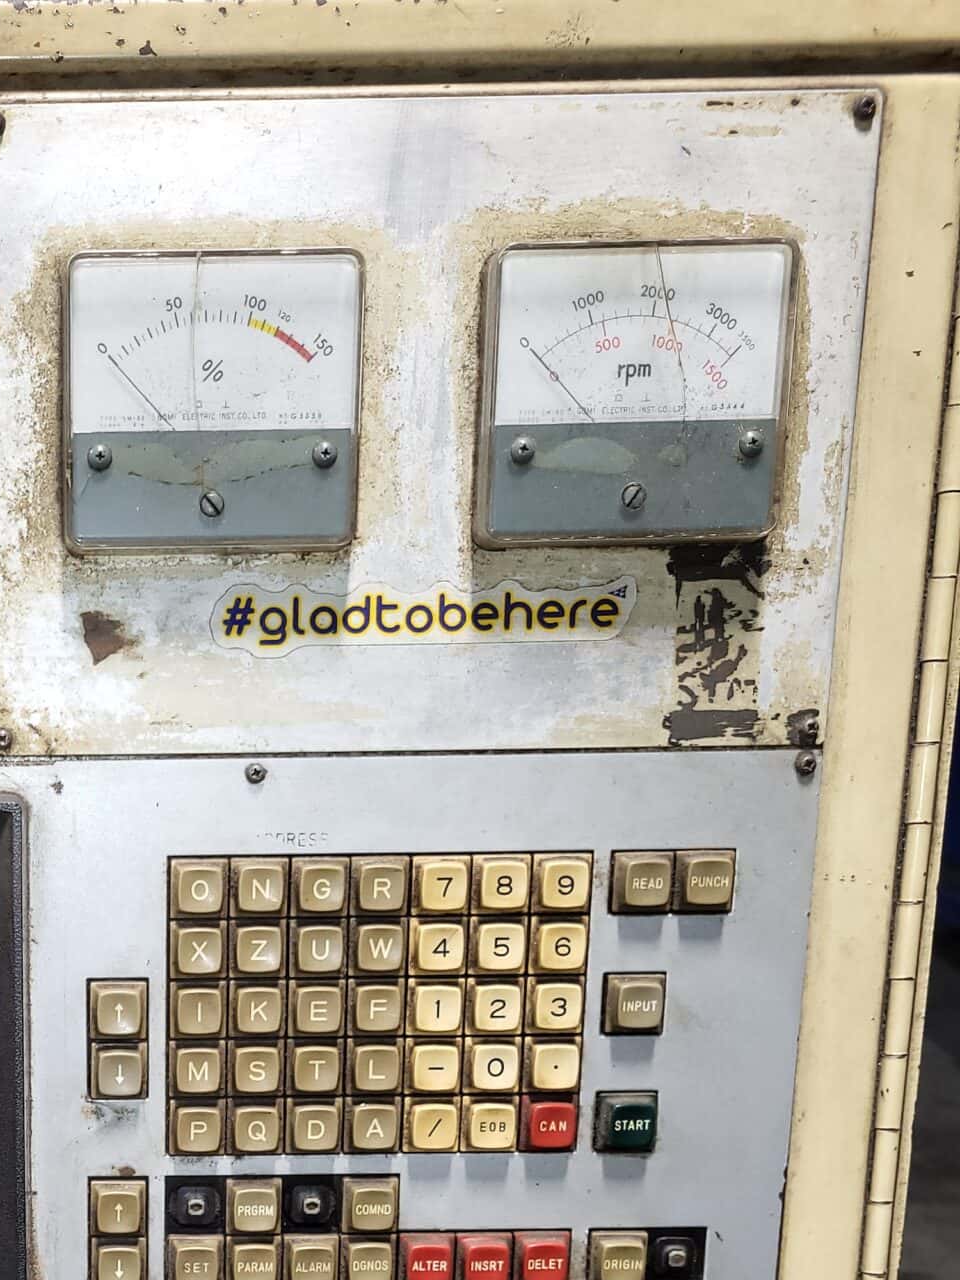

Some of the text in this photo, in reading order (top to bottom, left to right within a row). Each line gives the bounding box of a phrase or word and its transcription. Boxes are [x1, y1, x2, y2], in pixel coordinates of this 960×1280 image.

[572, 291, 605, 312] 1000
[641, 285, 676, 300] 2000
[165, 297, 183, 312] 50
[243, 294, 267, 312] 100
[705, 303, 738, 330] 3000
[97, 343, 108, 355] 0
[314, 333, 333, 357] 150
[519, 337, 530, 348] 0
[595, 337, 620, 353] 500
[651, 334, 683, 352] 1000
[202, 359, 224, 382] %
[617, 362, 652, 386] rpm
[702, 360, 727, 390] 1500
[222, 592, 619, 647] #gladtobehere
[252, 879, 271, 898] N
[313, 879, 330, 899] G
[373, 879, 390, 898] R
[437, 877, 453, 897] 7
[496, 876, 513, 895] 8
[558, 875, 575, 895] 9
[632, 877, 663, 890] READ
[691, 876, 729, 888] PUNCH
[191, 942, 207, 962] X
[251, 940, 268, 960] Z
[312, 940, 329, 960] U
[369, 938, 392, 959] W
[432, 938, 450, 957] 4
[493, 938, 510, 957] 5
[555, 937, 571, 956] 6
[250, 1001, 267, 1021] K
[310, 1001, 328, 1021] E
[370, 1000, 387, 1019] F
[435, 999, 441, 1018] 1
[490, 999, 506, 1018] 2
[551, 997, 567, 1017] 3
[622, 1000, 658, 1013] INPUT
[189, 1061, 208, 1080] M
[249, 1061, 265, 1080] S
[309, 1060, 326, 1080] T
[369, 1059, 386, 1079] L
[487, 1058, 505, 1076] 0
[190, 1122, 208, 1142] P
[248, 1121, 266, 1142] Q
[308, 1121, 325, 1139] D
[366, 1119, 384, 1138] A
[479, 1122, 506, 1133] EOB
[540, 1121, 567, 1132] CAN
[614, 1120, 651, 1131] START
[238, 1205, 274, 1217] PRGRM
[355, 1204, 391, 1215] COMND
[184, 1262, 209, 1273] SET
[238, 1262, 274, 1273] PARAM
[295, 1262, 331, 1273] ALARM
[353, 1260, 389, 1272] DGNOS
[412, 1260, 447, 1272] ALTER
[470, 1260, 505, 1272] INSRT
[527, 1259, 563, 1271] DELET
[603, 1260, 643, 1271] ORIGIN
